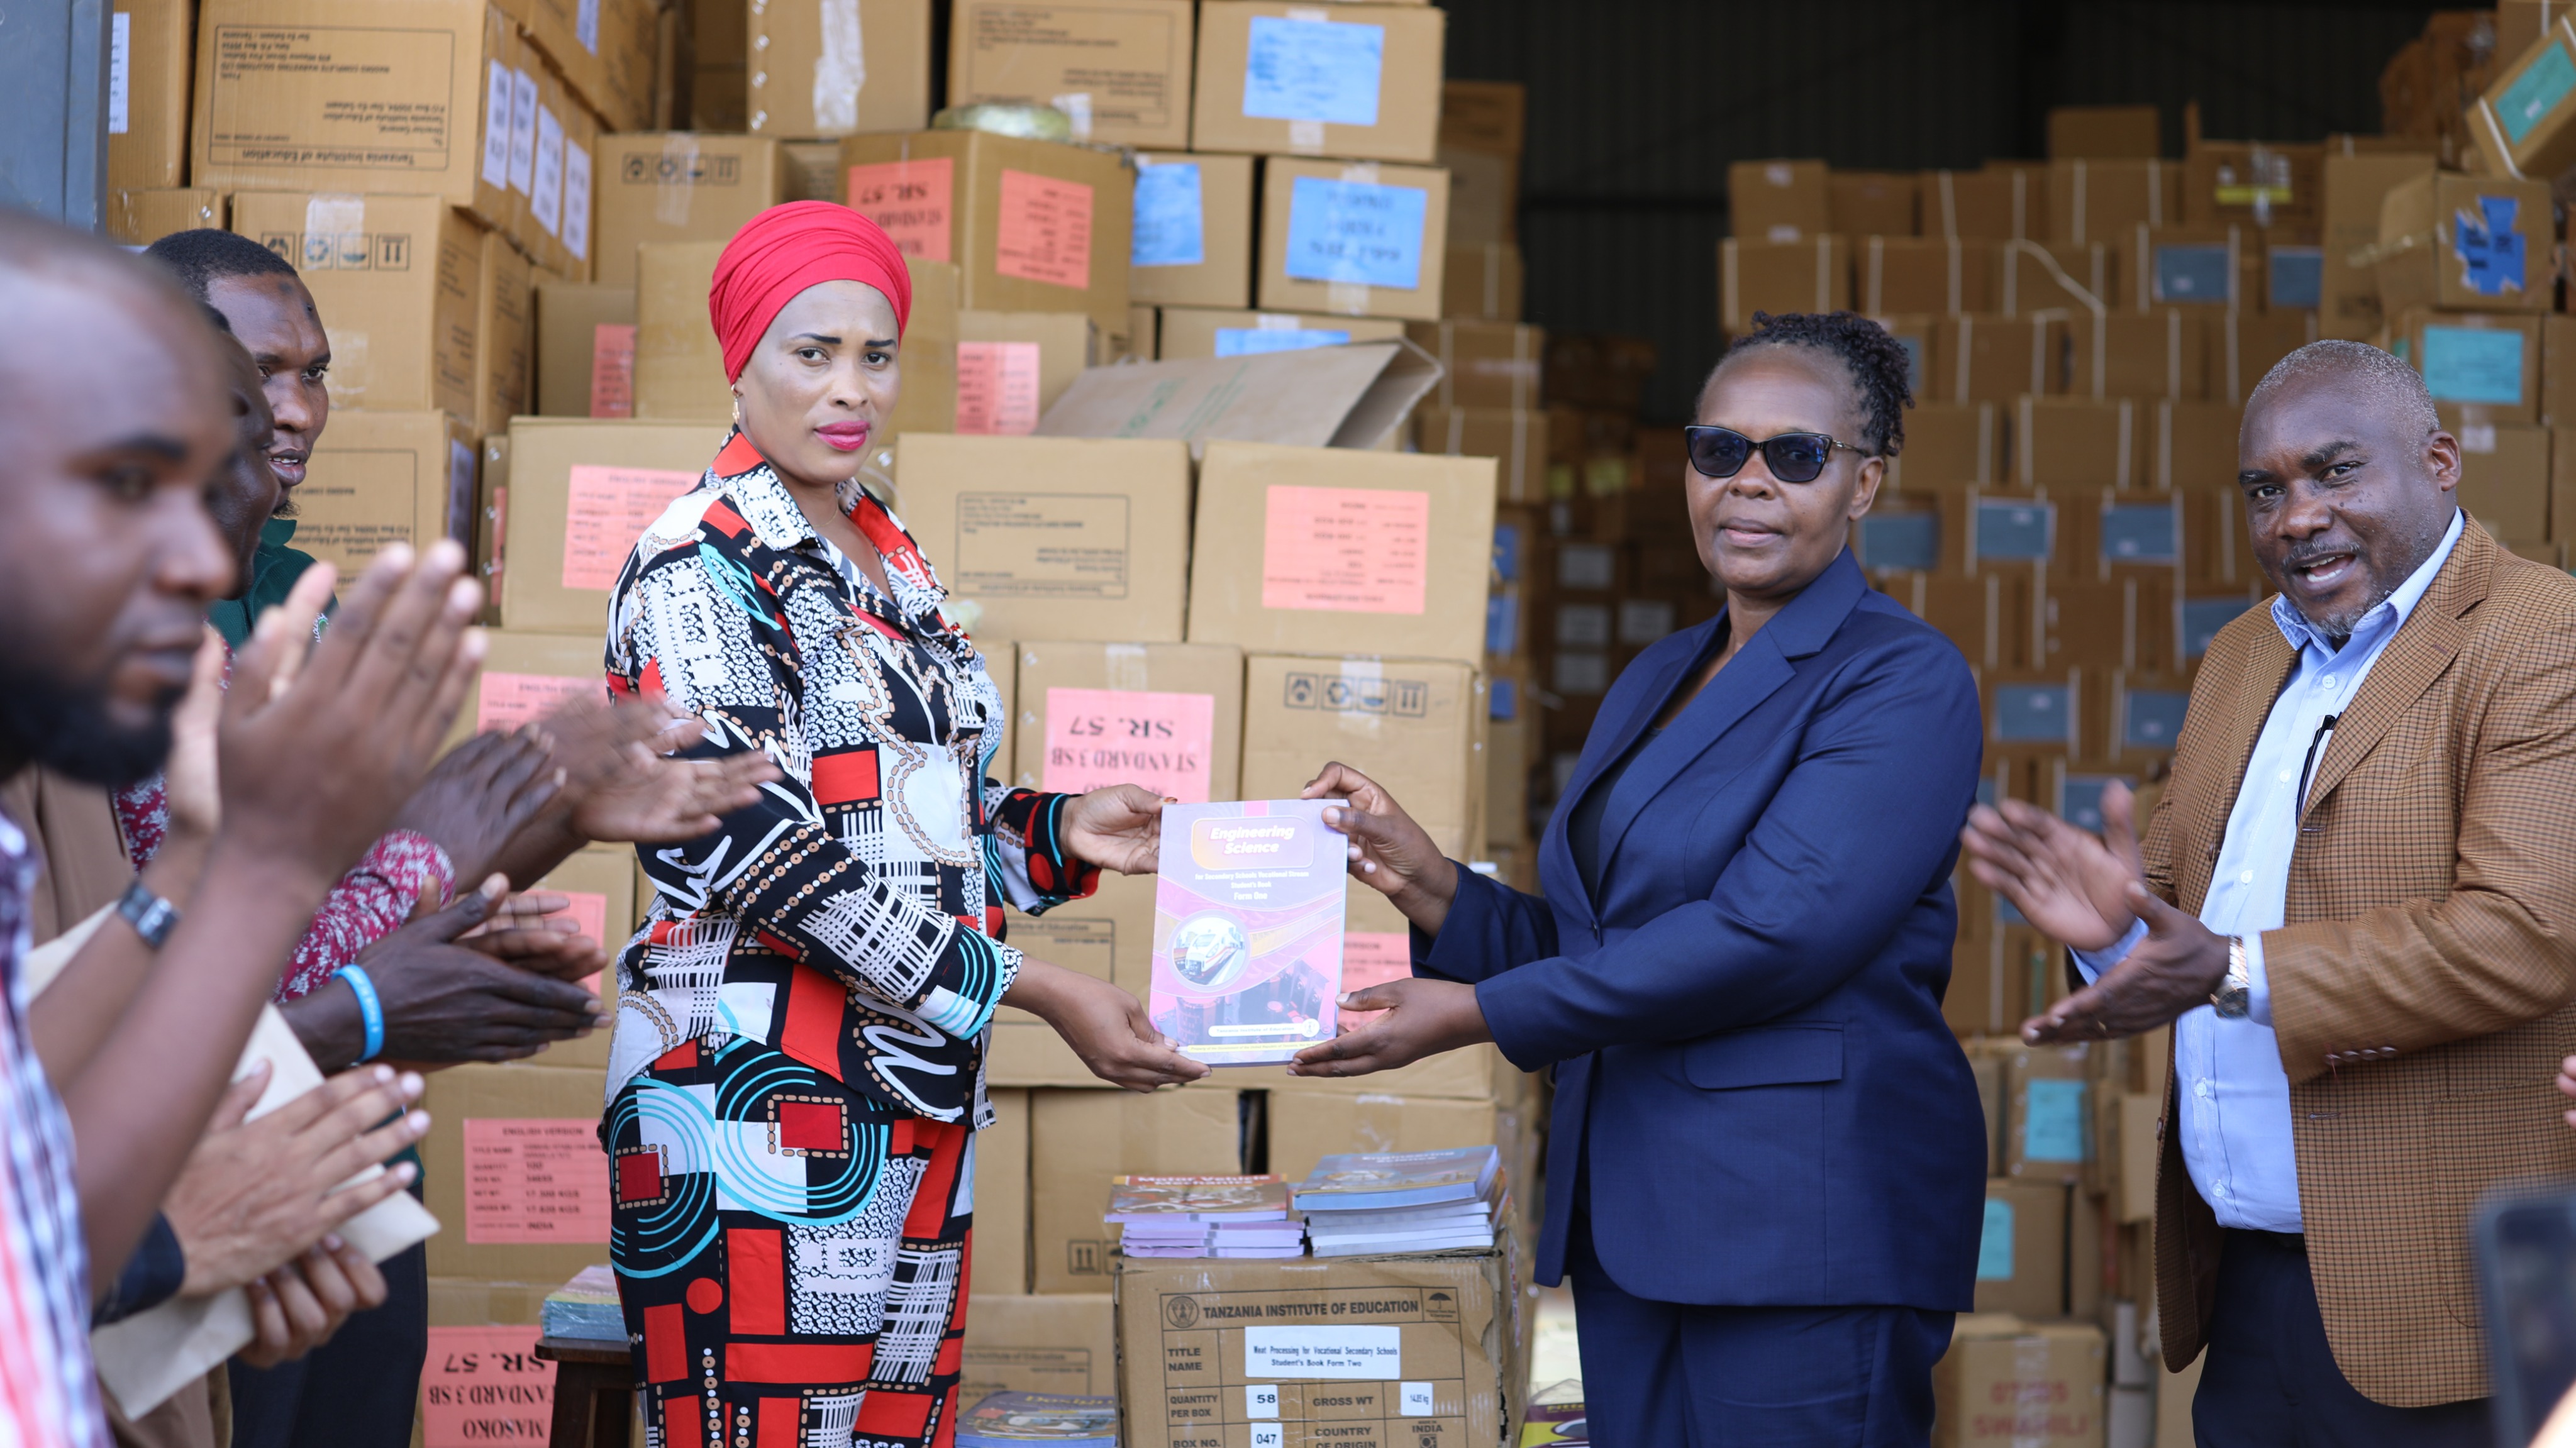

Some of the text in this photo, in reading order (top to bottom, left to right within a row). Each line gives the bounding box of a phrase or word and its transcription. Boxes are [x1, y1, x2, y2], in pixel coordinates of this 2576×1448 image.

[243, 148, 414, 165] Tanzania Institute of Education
[1069, 716, 1175, 739] SR. 57
[1051, 746, 1074, 767] SB
[1093, 748, 1197, 773] STANDARD
[1210, 825, 1296, 841] Engineering
[1223, 842, 1280, 855] Science
[1234, 892, 1268, 900] Form One
[502, 1127, 585, 1136] ENGLISH VERSION
[1203, 1300, 1419, 1318] TANZANIA INSTITUTE OF EDUCATION
[1167, 1347, 1201, 1357] TITLE
[1270, 1346, 1299, 1356] Processing
[1313, 1346, 1342, 1355] Vocational
[1345, 1346, 1374, 1357] Secondary
[1376, 1346, 1398, 1355] Schools
[443, 1352, 546, 1373] SR. 57
[1168, 1362, 1202, 1372] NAME
[1271, 1359, 1304, 1367] Student's
[429, 1384, 452, 1405] SB
[469, 1384, 556, 1405] ANDARD
[1170, 1395, 1218, 1405] QUANTITY
[1257, 1394, 1276, 1403] 58
[1313, 1396, 1374, 1407] GROSS WT
[1192, 1408, 1212, 1417] BOX
[462, 1418, 545, 1440] MASOKO
[1315, 1427, 1372, 1437] COUNTRY
[1412, 1425, 1443, 1434] INDIA
[1172, 1439, 1221, 1448] BOX NO.
[1256, 1434, 1277, 1444] 047
